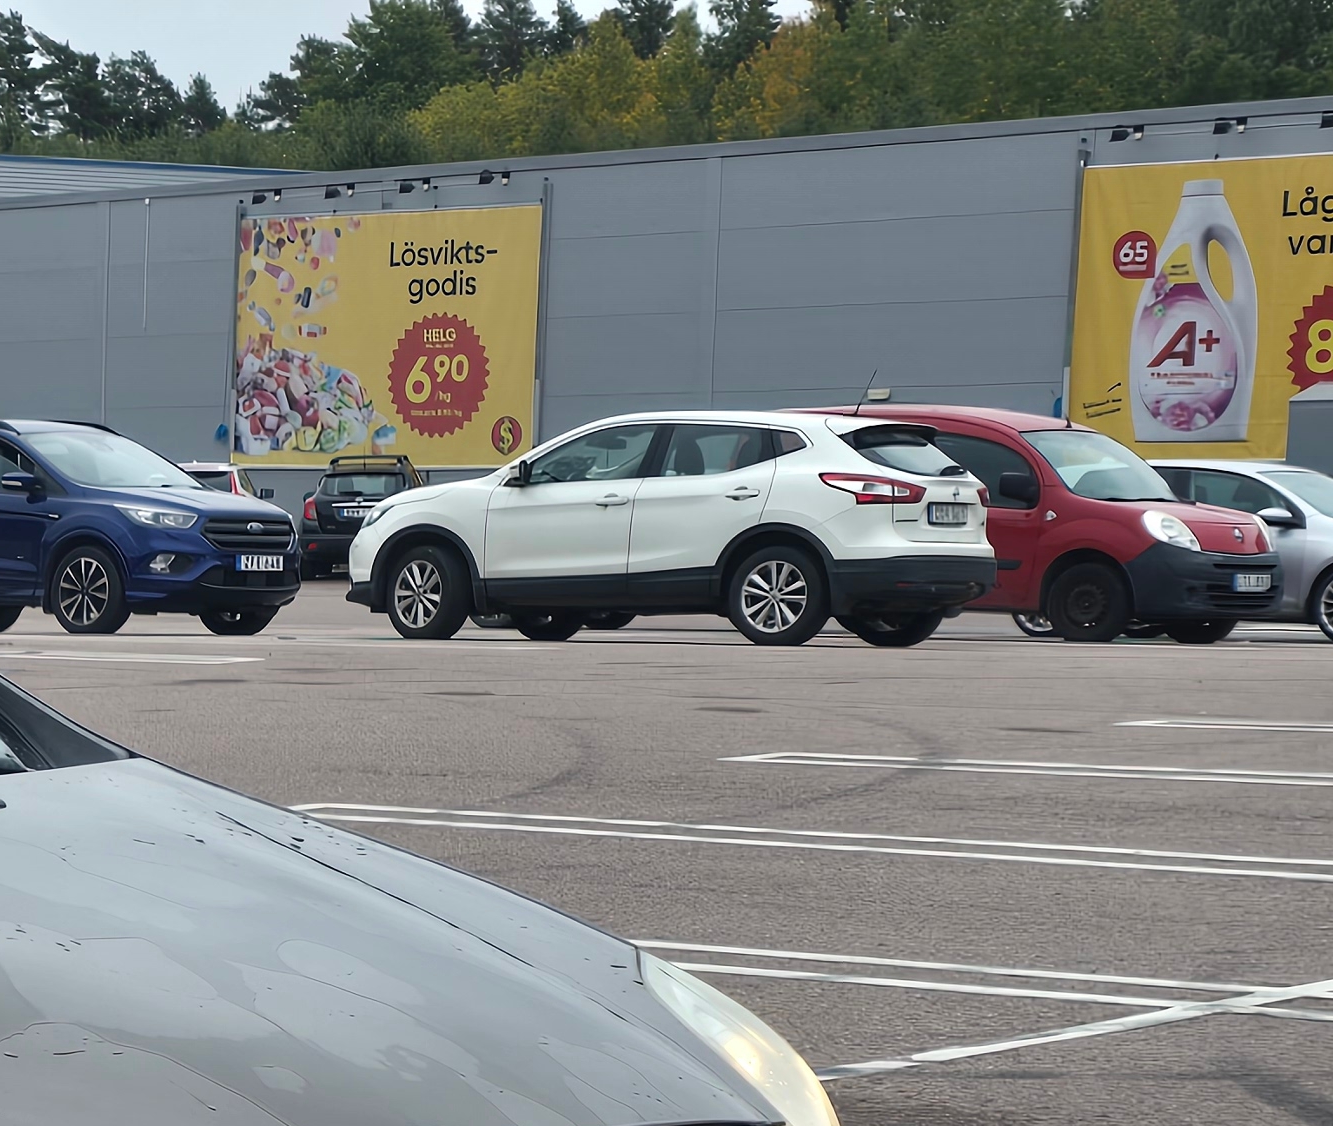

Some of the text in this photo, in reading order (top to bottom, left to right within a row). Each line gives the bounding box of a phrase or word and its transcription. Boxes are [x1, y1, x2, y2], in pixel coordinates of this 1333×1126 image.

[390, 240, 497, 267] Lösvikts-
[1119, 241, 1148, 263] 65
[408, 270, 476, 303] godis
[1146, 321, 1220, 368] A+
